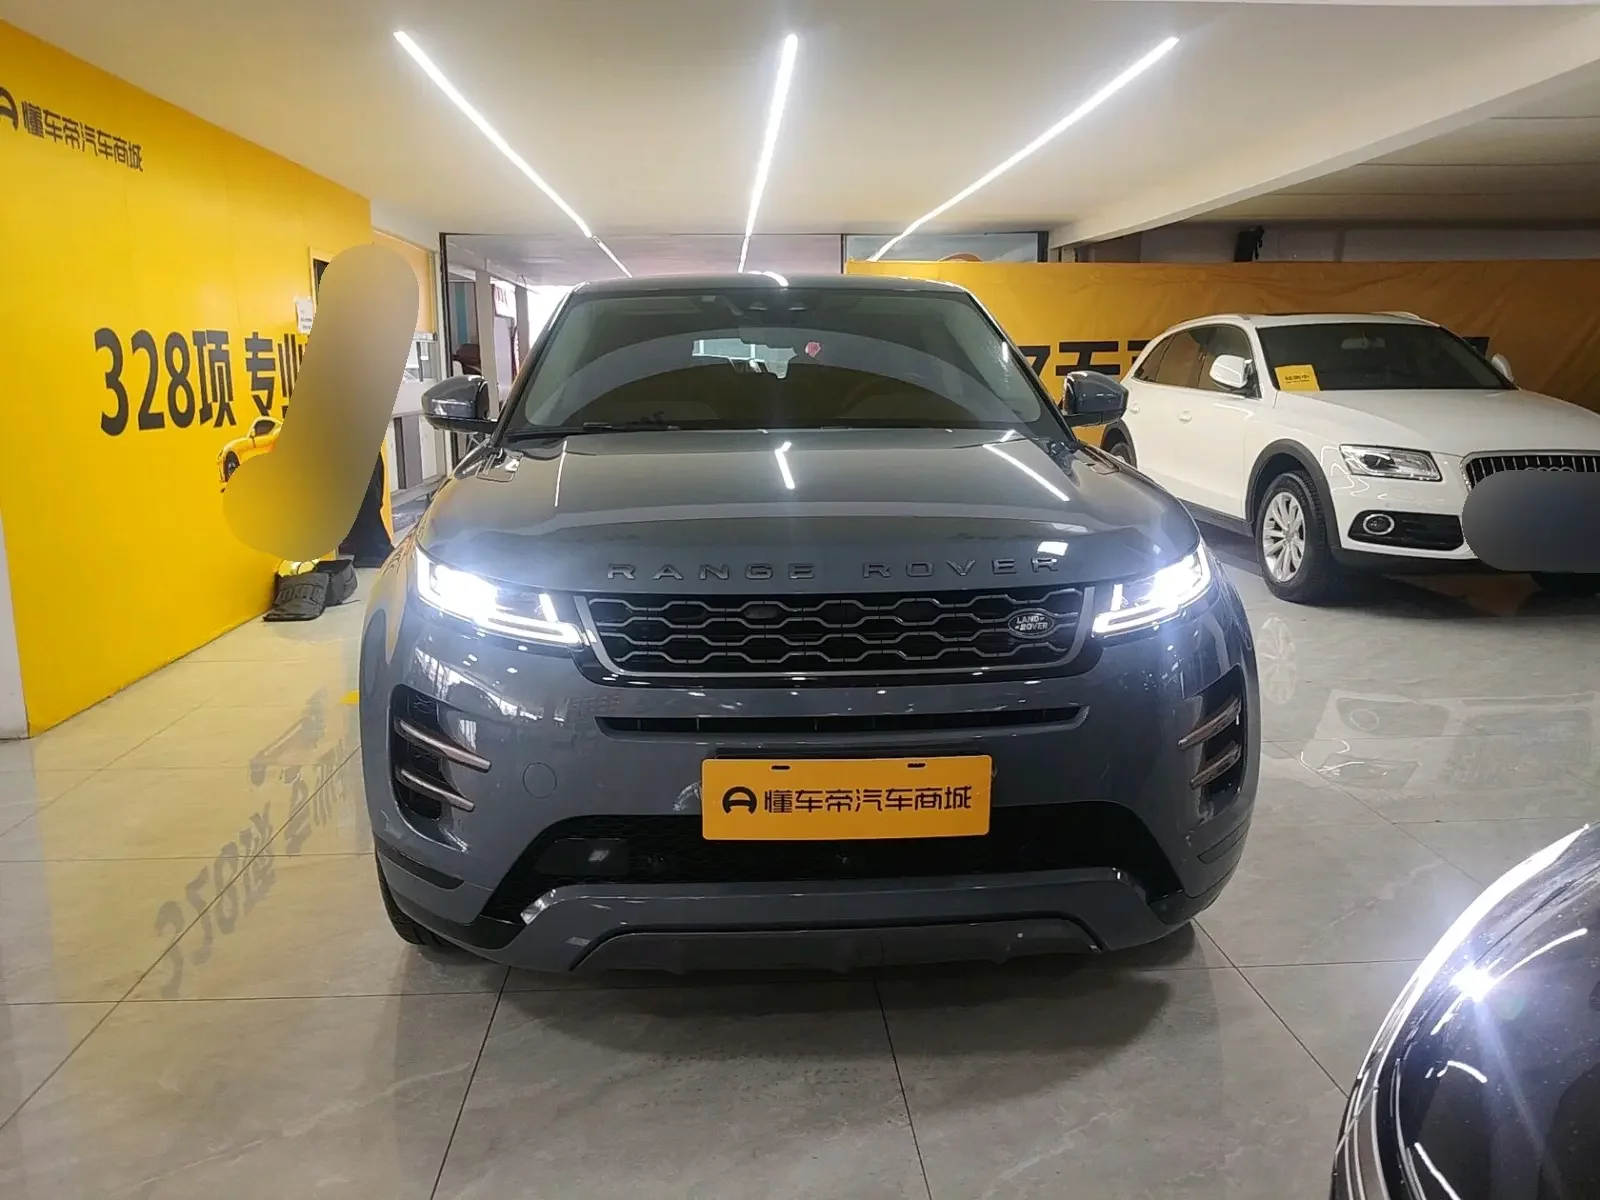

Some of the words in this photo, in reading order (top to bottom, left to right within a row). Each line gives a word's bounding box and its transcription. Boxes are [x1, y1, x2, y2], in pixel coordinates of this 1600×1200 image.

[21, 100, 143, 172] 懂车帝汽车商城
[606, 562, 816, 581] RANGE
[862, 556, 1059, 579] ROVER
[1016, 615, 1041, 625] LAND
[1019, 622, 1049, 631] ROVER
[763, 785, 973, 814] 懂车帝汽车商城
